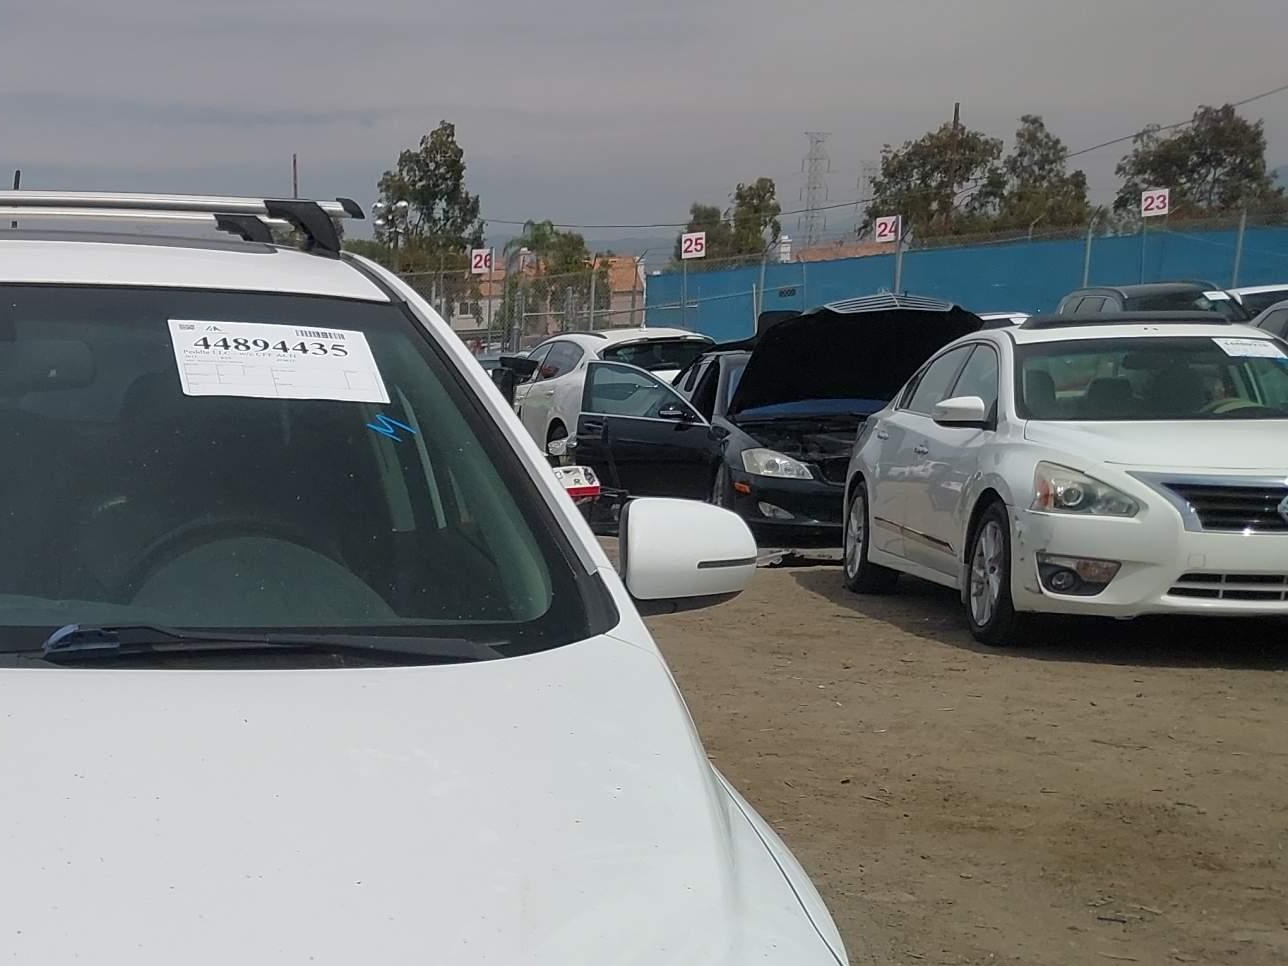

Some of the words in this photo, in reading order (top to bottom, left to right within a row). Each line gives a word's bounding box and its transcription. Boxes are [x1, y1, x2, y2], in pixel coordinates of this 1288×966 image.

[1144, 194, 1167, 211] 23
[877, 220, 896, 237] 24
[683, 237, 704, 254] 25
[193, 335, 349, 357] 44894435
